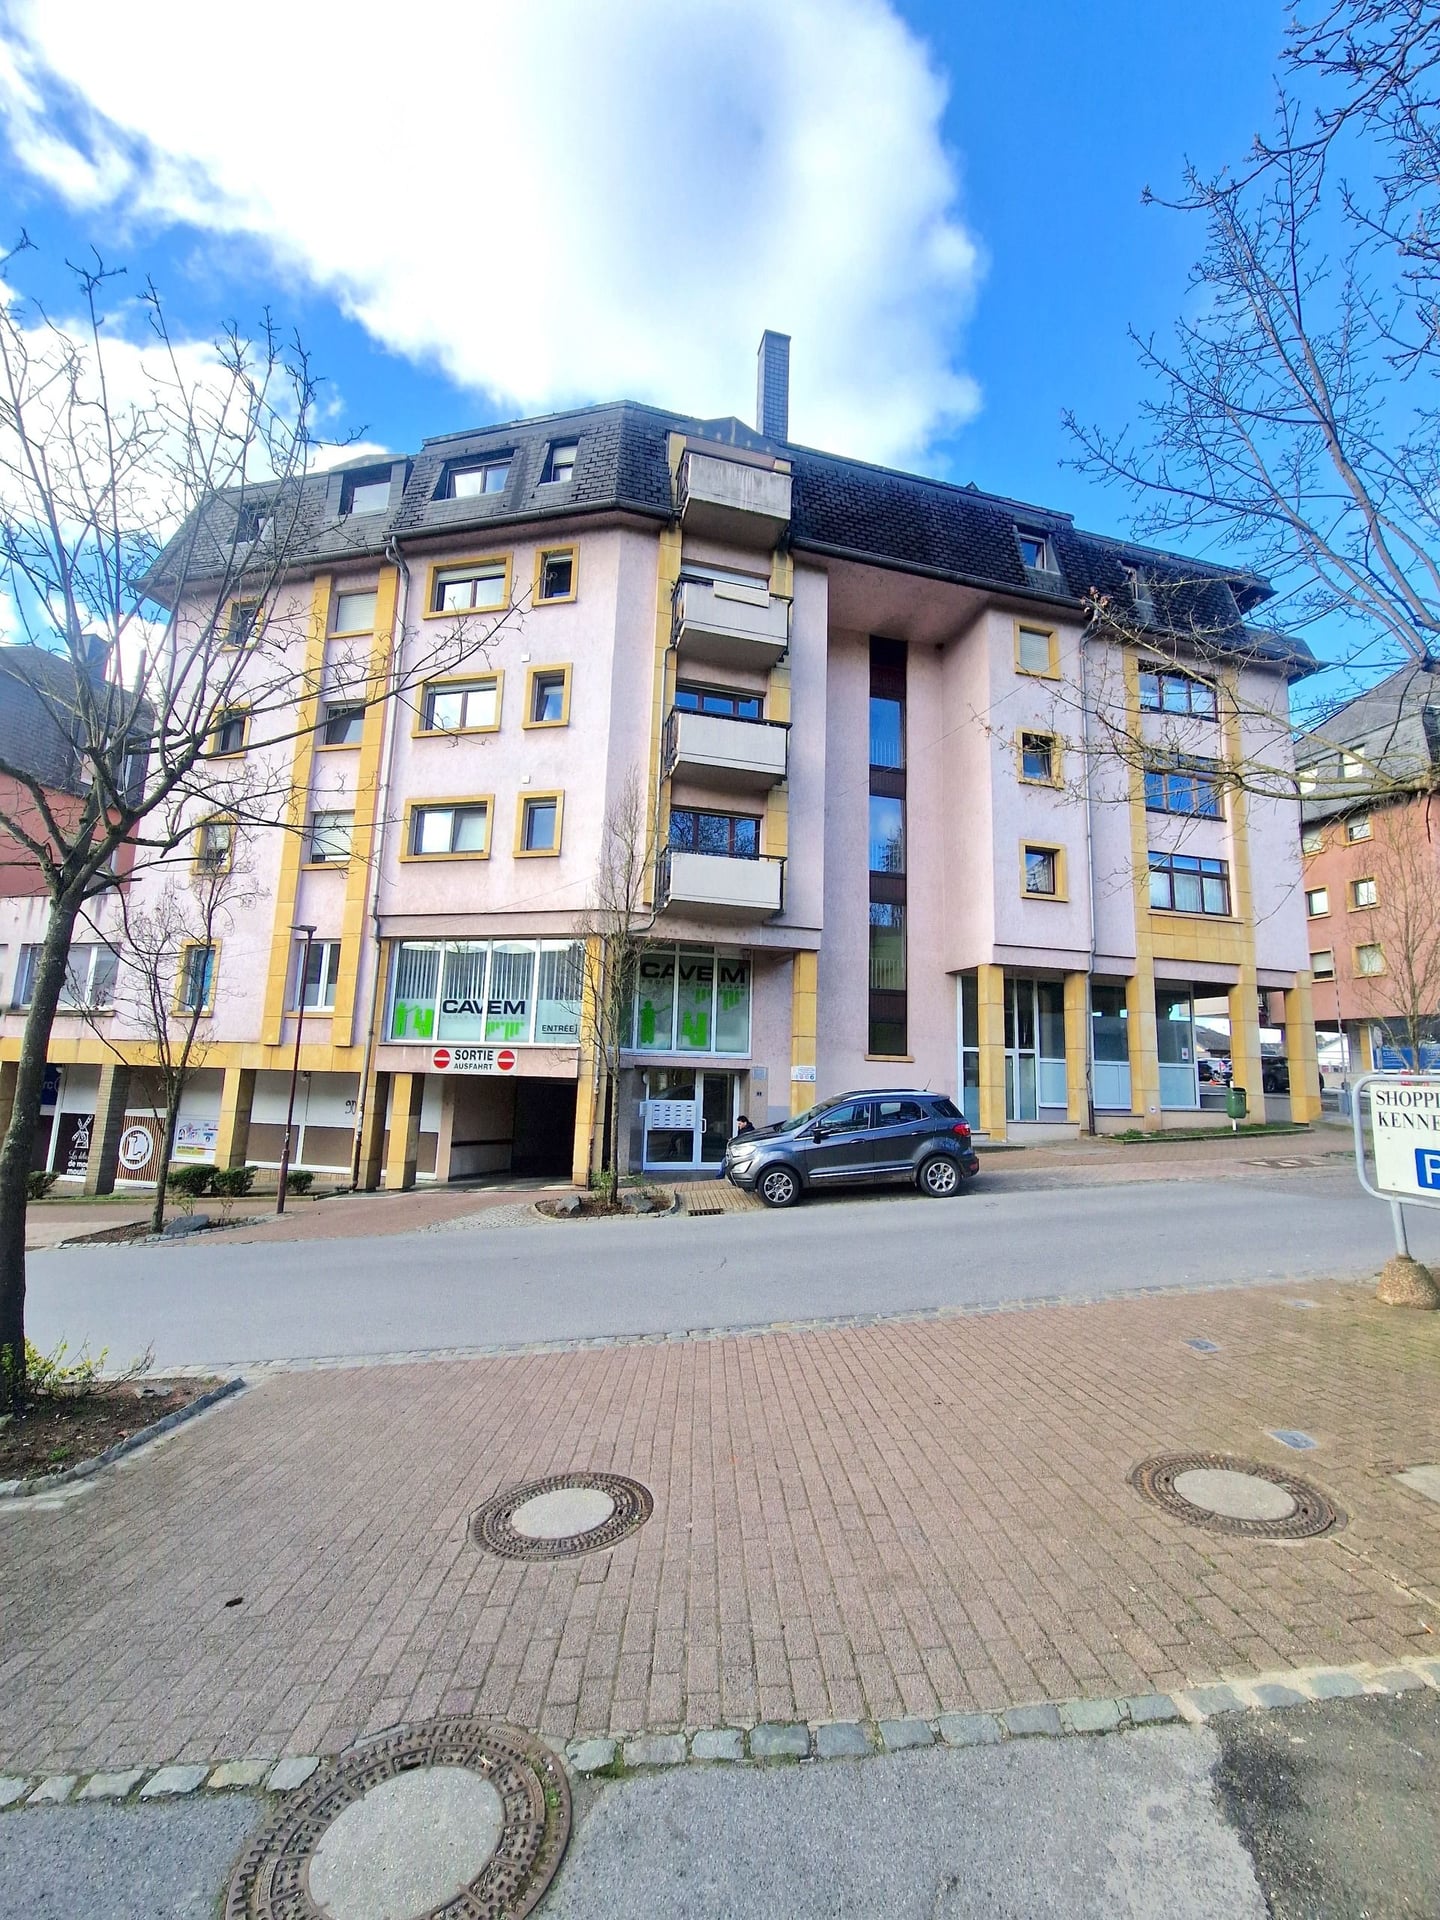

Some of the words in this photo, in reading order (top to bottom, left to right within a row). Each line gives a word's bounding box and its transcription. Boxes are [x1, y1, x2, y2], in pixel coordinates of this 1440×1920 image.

[641, 962, 745, 983] CAVEM
[442, 999, 525, 1015] CAVEM
[454, 1050, 494, 1061] SORTIE
[1424, 1153, 1440, 1185] P
